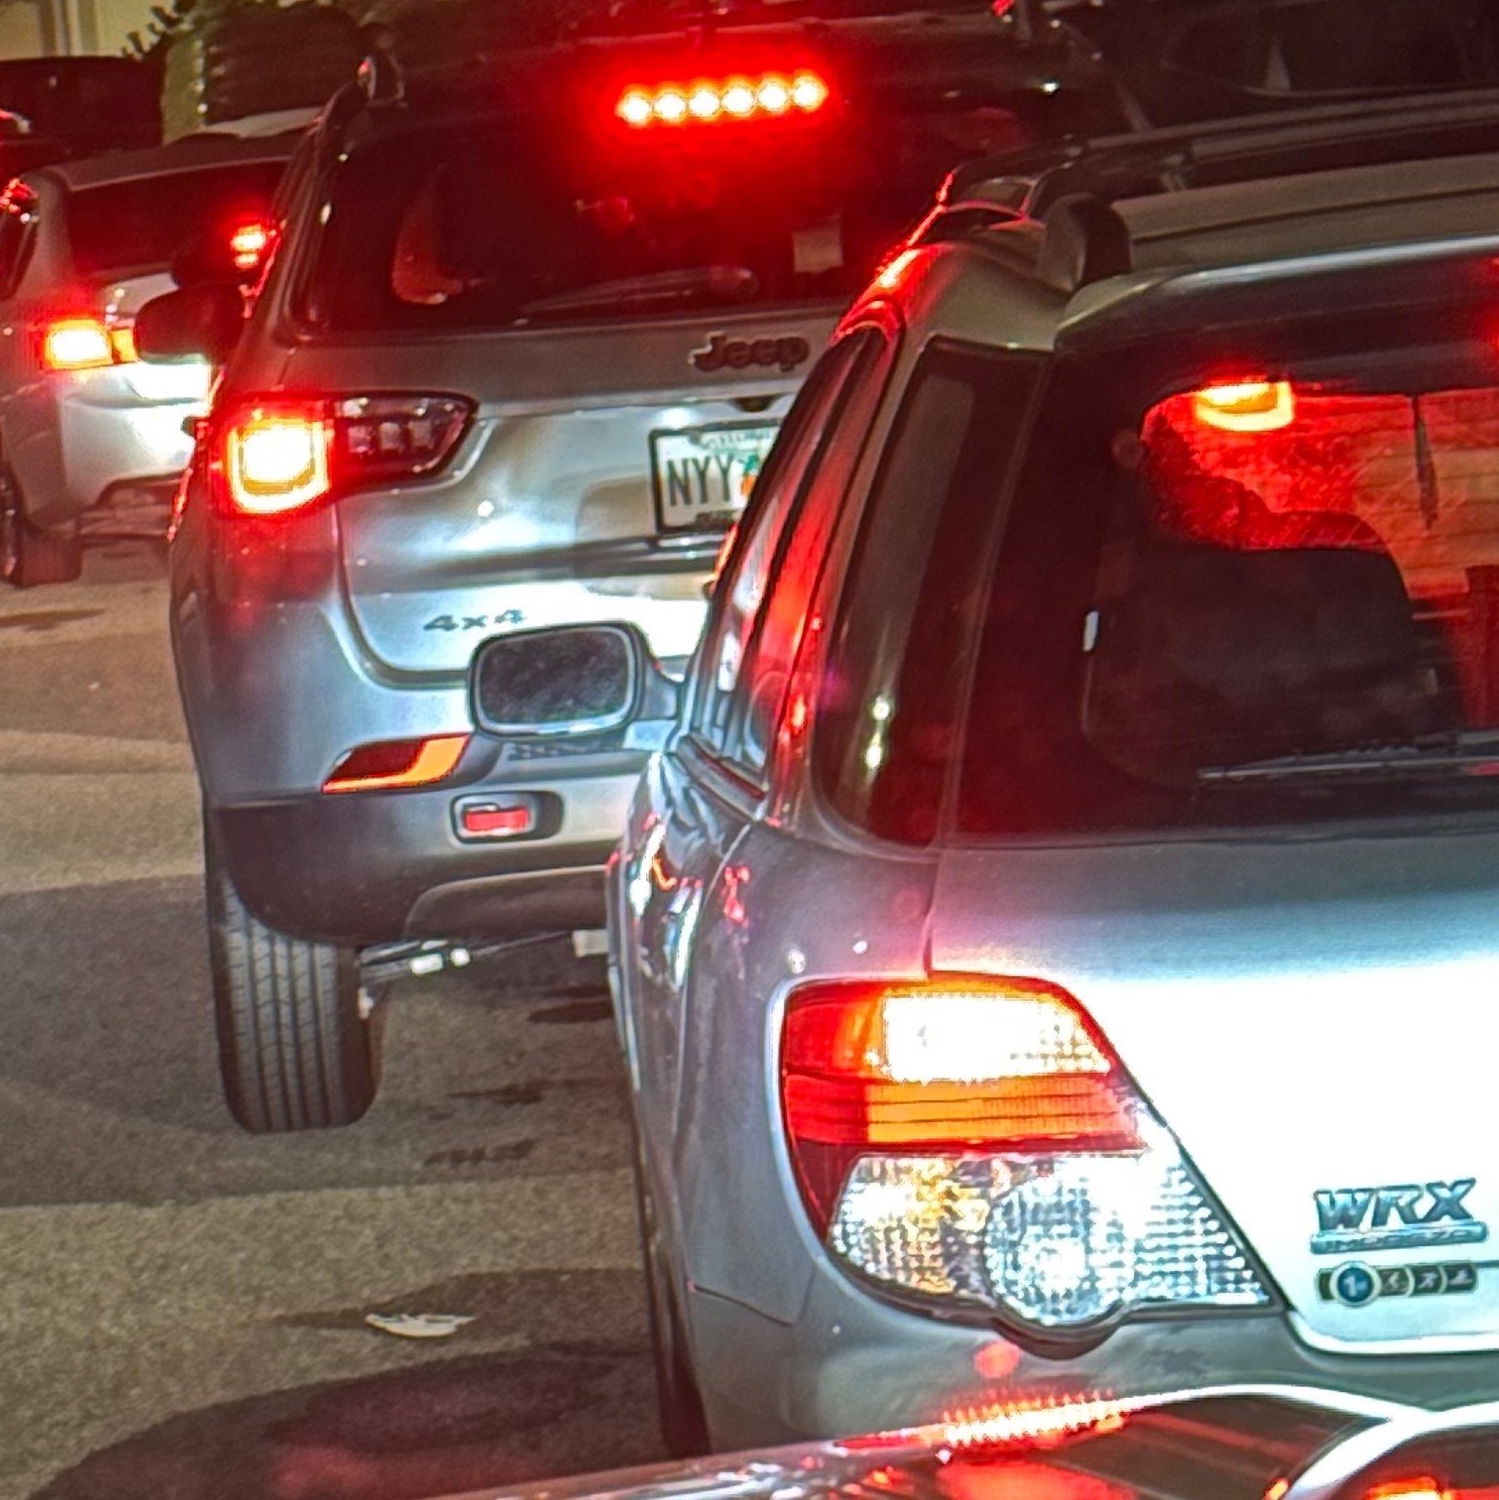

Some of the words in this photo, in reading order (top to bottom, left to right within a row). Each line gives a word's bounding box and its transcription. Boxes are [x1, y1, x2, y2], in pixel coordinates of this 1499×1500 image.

[689, 331, 810, 372] Jeep
[666, 451, 736, 507] NYY
[1313, 1177, 1477, 1232] WRX
